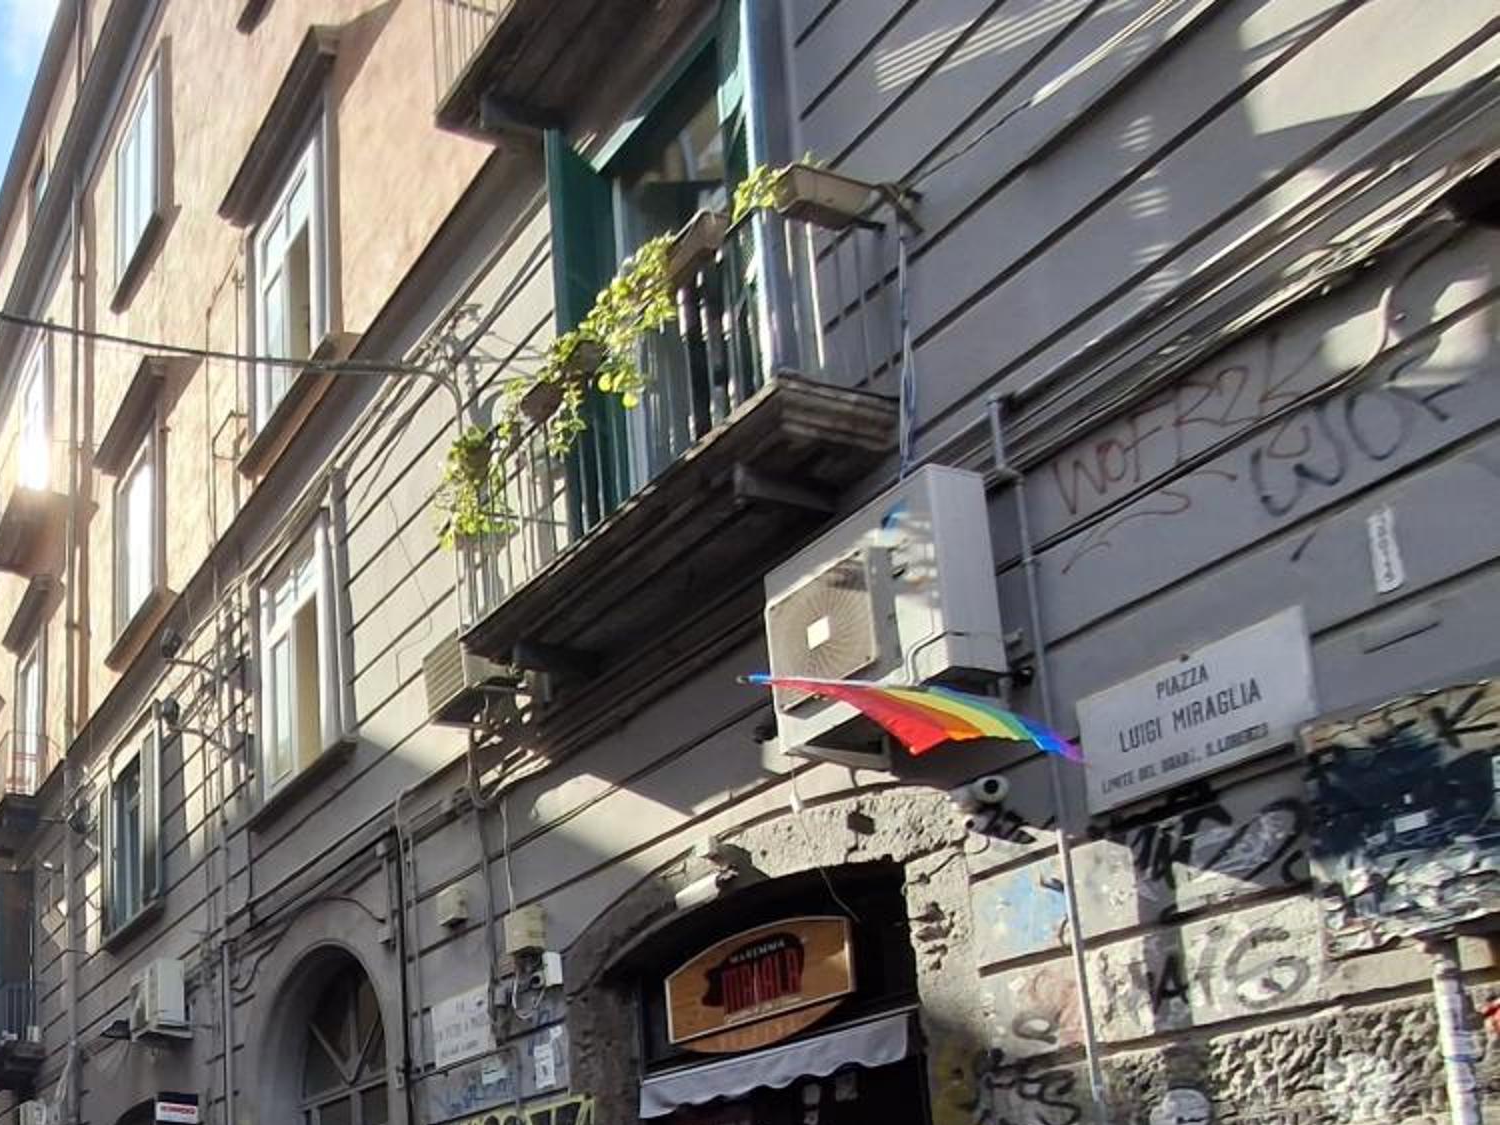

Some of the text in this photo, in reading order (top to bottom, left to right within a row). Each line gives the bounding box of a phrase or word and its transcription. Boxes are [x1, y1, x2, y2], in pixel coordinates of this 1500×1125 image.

[1156, 663, 1209, 700] PIAZZA
[1118, 677, 1262, 754] LUIGI MIRAGLIA
